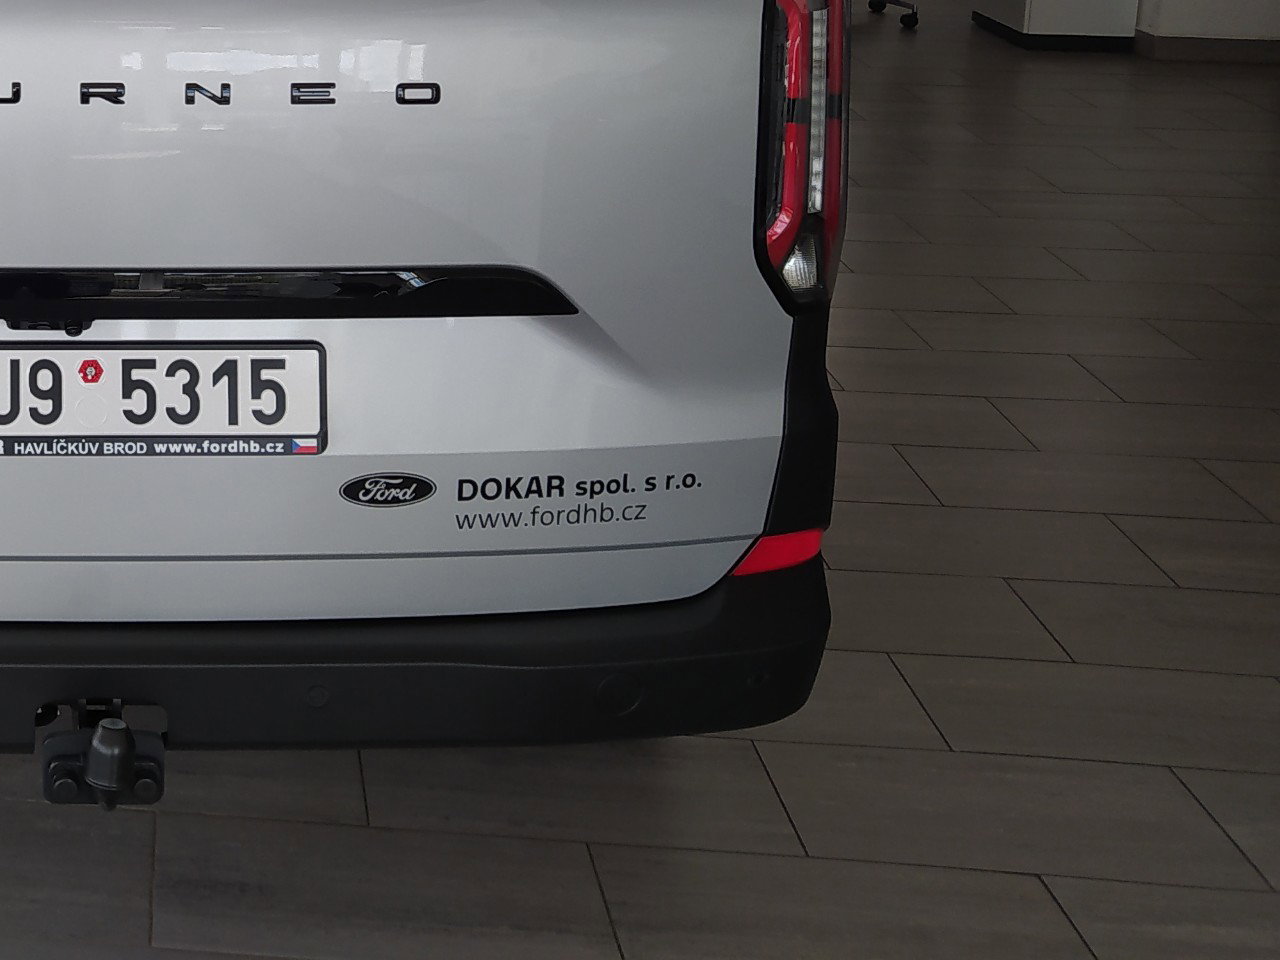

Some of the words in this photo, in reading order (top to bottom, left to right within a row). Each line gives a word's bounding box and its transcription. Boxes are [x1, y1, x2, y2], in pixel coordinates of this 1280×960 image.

[121, 358, 286, 426] 5315
[14, 438, 100, 455] HAVLÍČKŮV
[103, 442, 148, 455] BROD
[154, 440, 285, 454] www.fordhb.cz
[457, 475, 566, 502] DOKAR
[575, 473, 636, 499] spol.
[644, 476, 657, 492] s
[665, 472, 702, 491] r.o.
[455, 501, 647, 530] www.fordhb.cz
